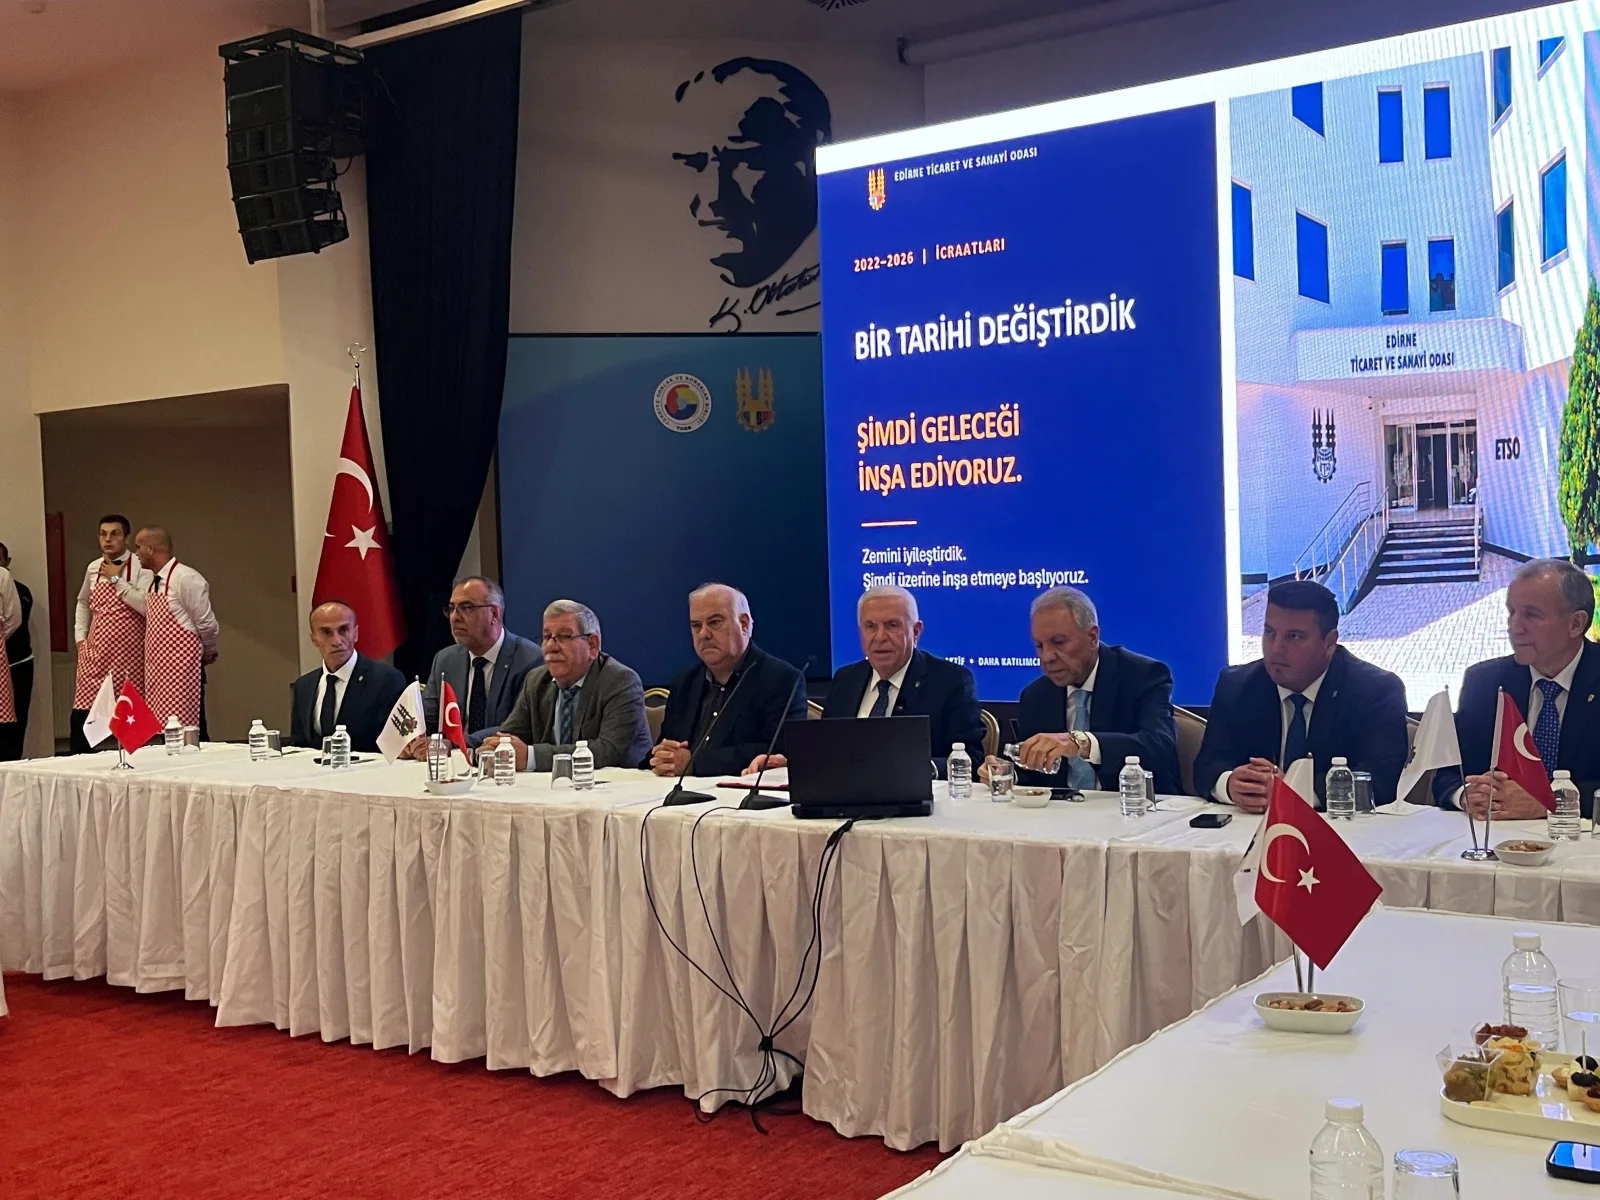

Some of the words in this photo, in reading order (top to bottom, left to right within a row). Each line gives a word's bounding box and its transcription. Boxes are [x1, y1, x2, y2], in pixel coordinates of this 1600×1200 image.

[894, 166, 924, 182] EDİRNE
[926, 160, 961, 176] TİCARET
[962, 158, 974, 170] VE
[975, 150, 1008, 168] SANAYİ
[1010, 147, 1038, 161] ODASI
[935, 238, 1005, 260] İCRAATLARI
[855, 323, 892, 360] BİR
[896, 311, 972, 356] TARİHİ
[979, 293, 1136, 347] DEĞİŞTİRDİK
[1386, 330, 1417, 349] EDİRNE
[1350, 355, 1383, 373] TİCARET
[1385, 356, 1396, 370] VE
[1397, 350, 1427, 369] SANAYİ
[1429, 352, 1455, 367] ODASI
[857, 412, 917, 454] ŞİMDİ
[921, 403, 1020, 443] GELECEĞİ
[1495, 437, 1521, 460] ETSO
[858, 460, 907, 496] İNŞA
[910, 455, 1023, 489] EDİYORUZ.
[861, 546, 901, 564] Zemini
[903, 545, 967, 567] iyileştirdik.
[862, 571, 896, 592] Şimdi
[897, 571, 941, 588] üzerine
[942, 570, 969, 590] inşa
[970, 571, 1017, 590] etmeye
[1018, 568, 1089, 590] başlıyoruz.
[978, 656, 1000, 667] DAHA
[1001, 657, 1041, 667] KATILIMCI
